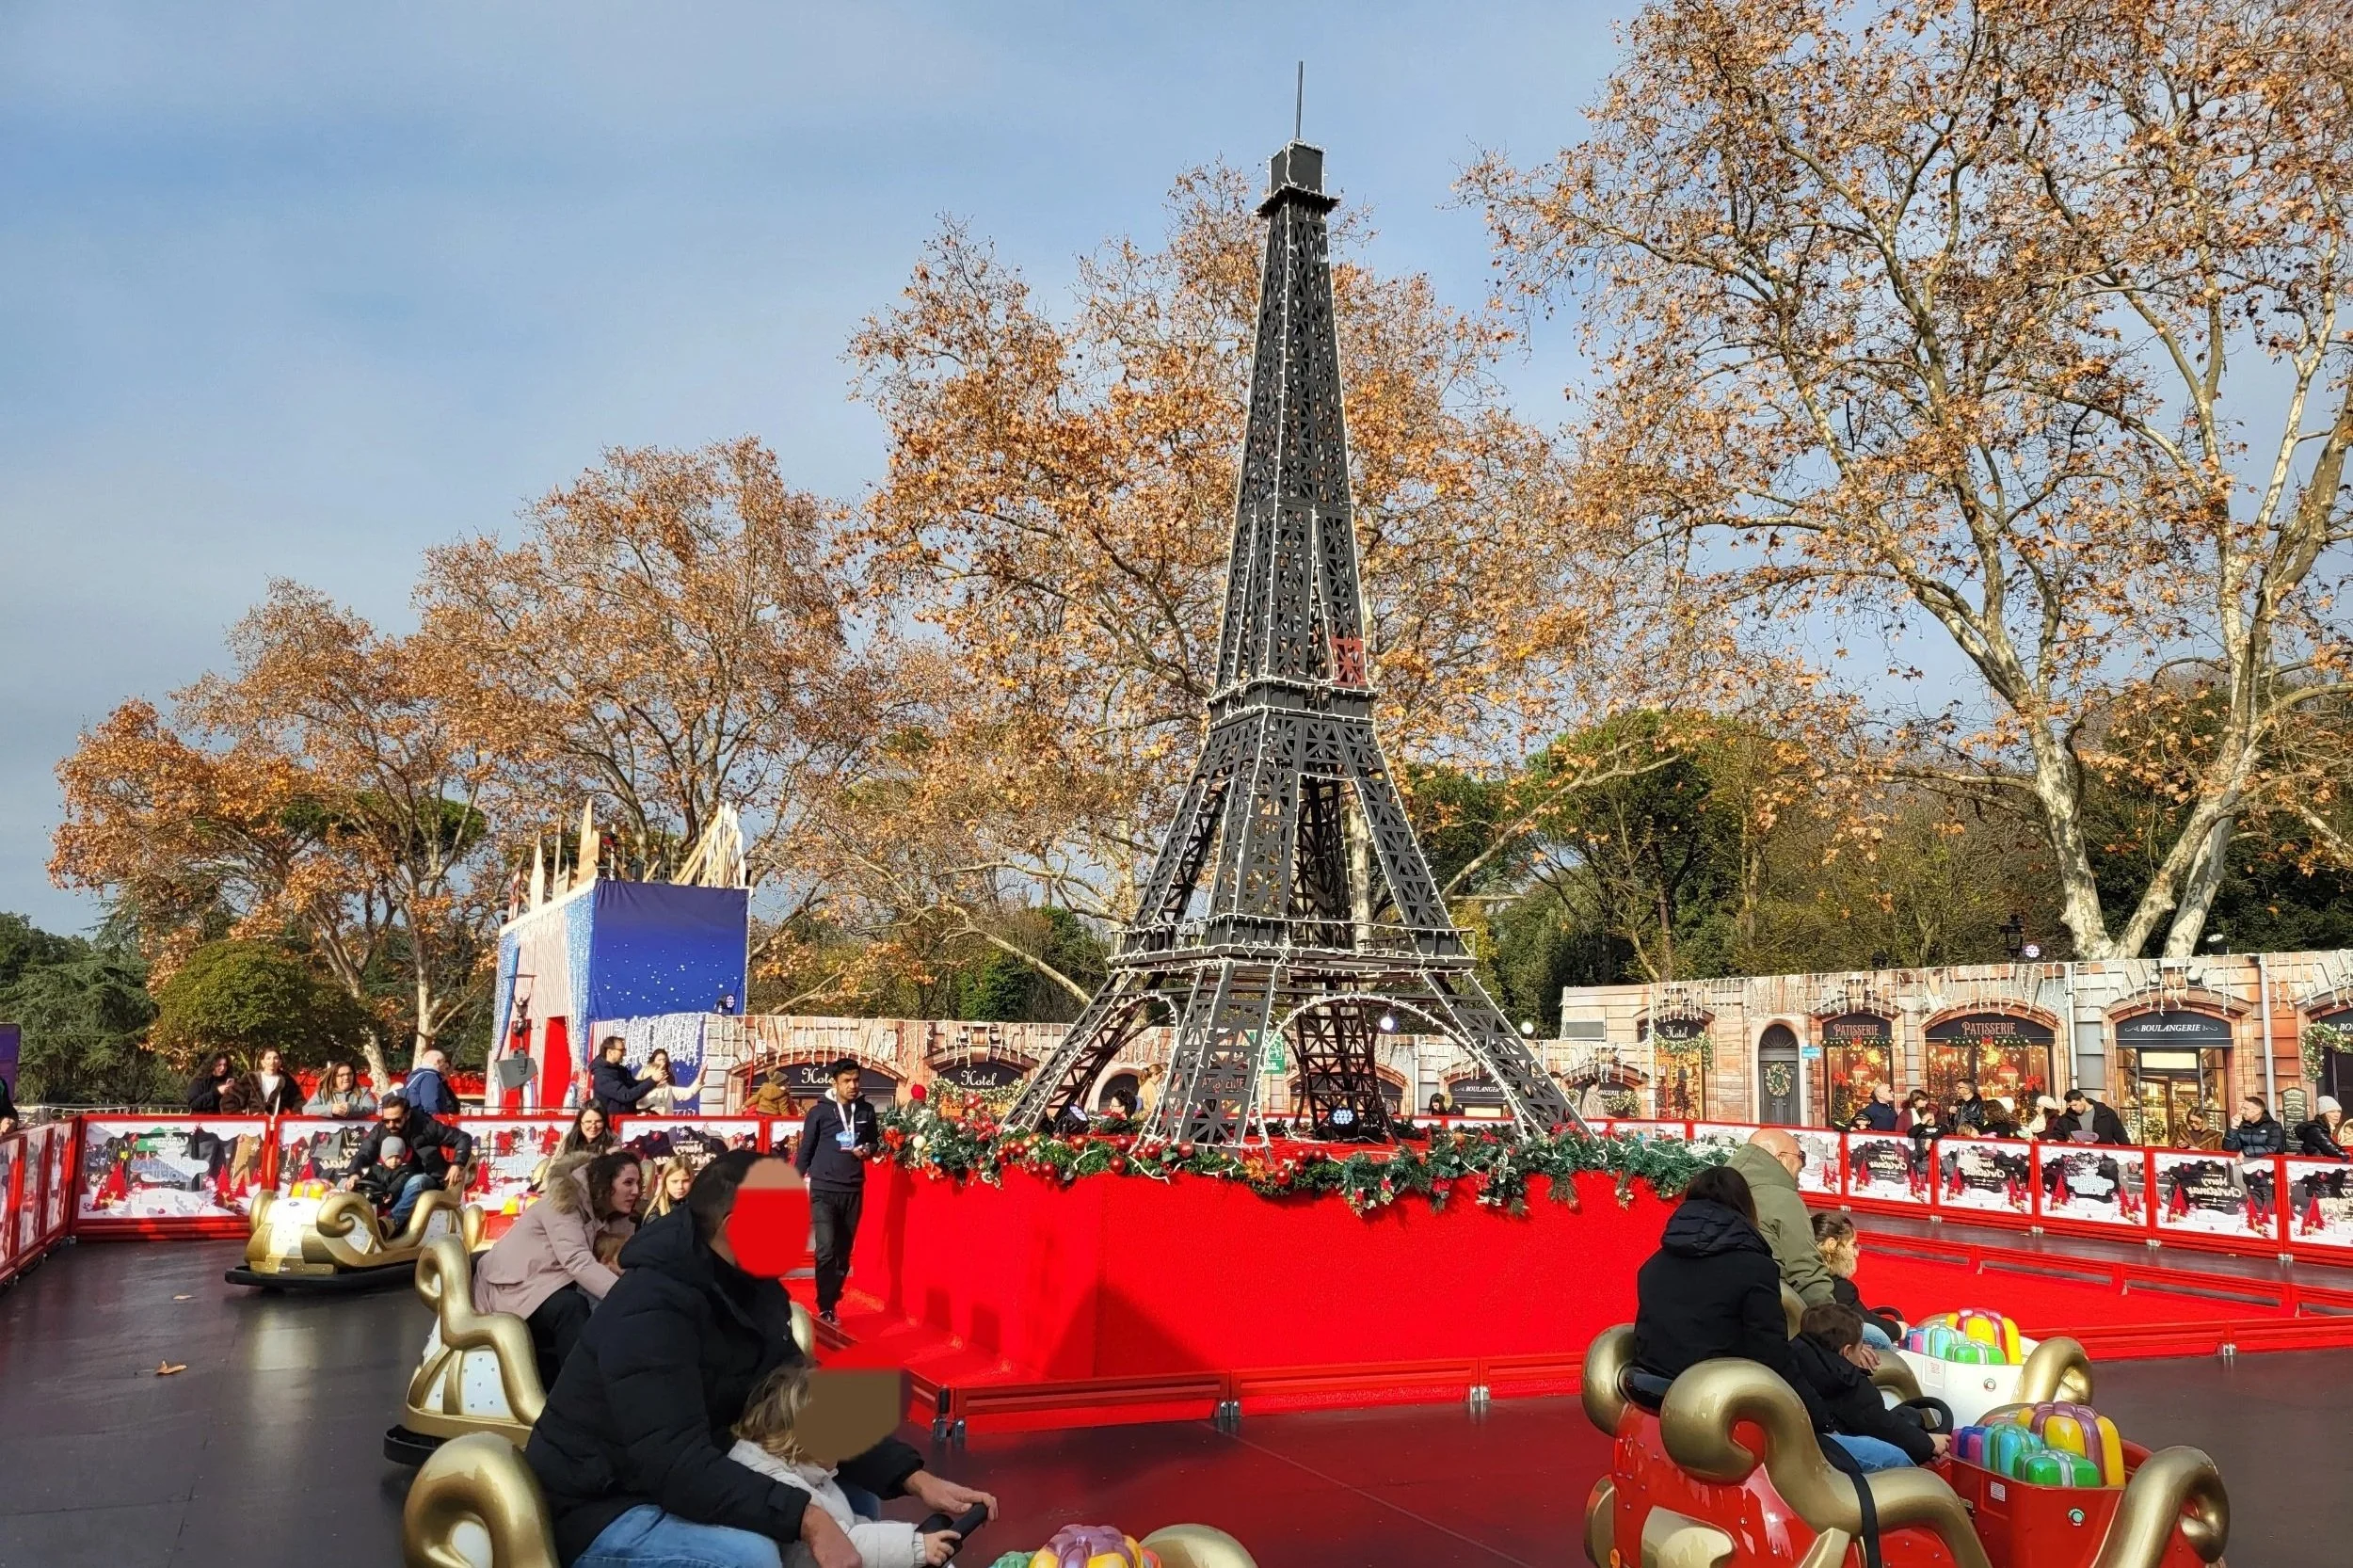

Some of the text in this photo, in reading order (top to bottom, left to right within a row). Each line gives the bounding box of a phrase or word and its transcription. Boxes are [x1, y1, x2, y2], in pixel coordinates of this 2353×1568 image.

[1665, 1025, 1689, 1039] Hotel
[1833, 1024, 1880, 1036] PATISSERIE
[1961, 1021, 2016, 1035] PATISSERIE
[2140, 1024, 2201, 1032] BOULANGERIE
[801, 1067, 835, 1084] Hote
[960, 1069, 997, 1086] Hotel
